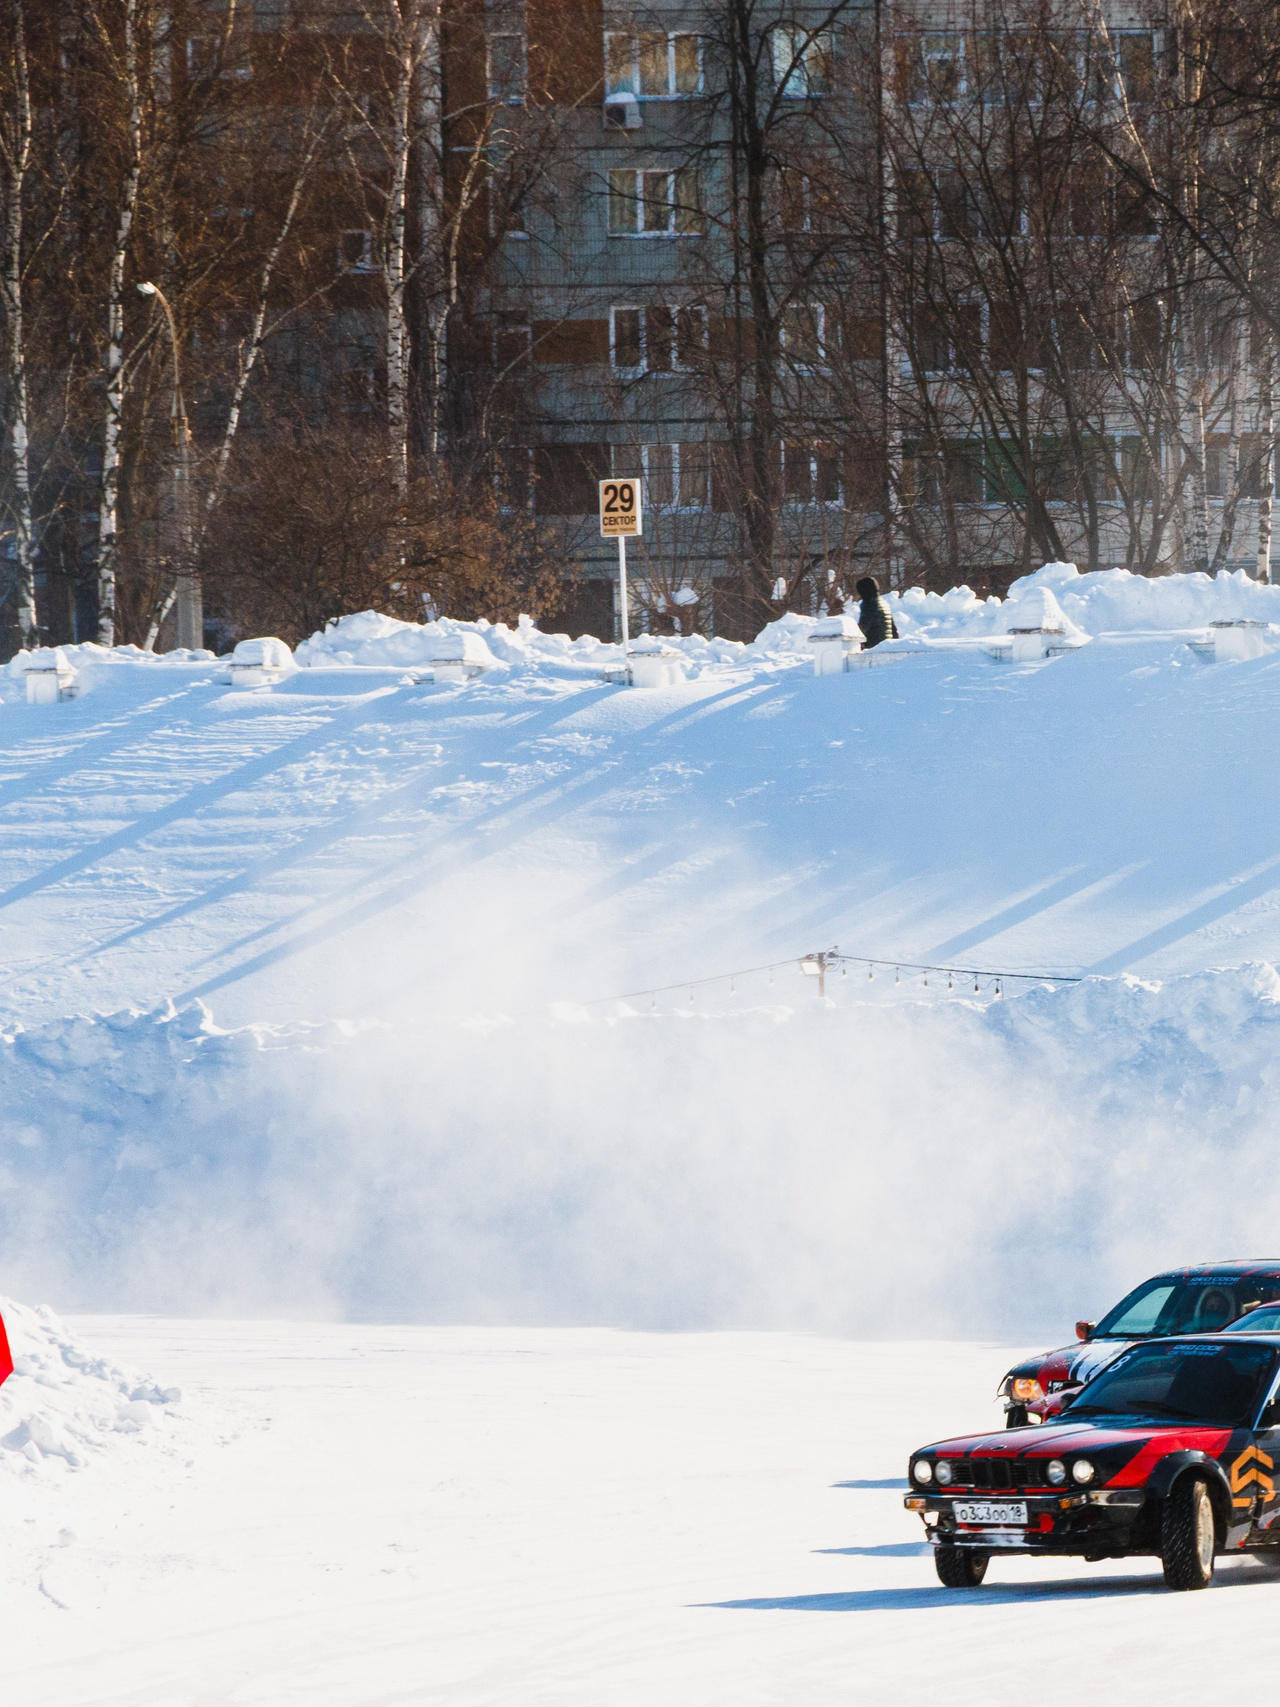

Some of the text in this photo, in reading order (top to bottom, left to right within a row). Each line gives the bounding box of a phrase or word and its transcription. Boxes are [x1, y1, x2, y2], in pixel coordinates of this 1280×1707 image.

[604, 483, 634, 513] 29
[602, 515, 636, 526] СЕКТОР
[1009, 1505, 1022, 1517] 18
